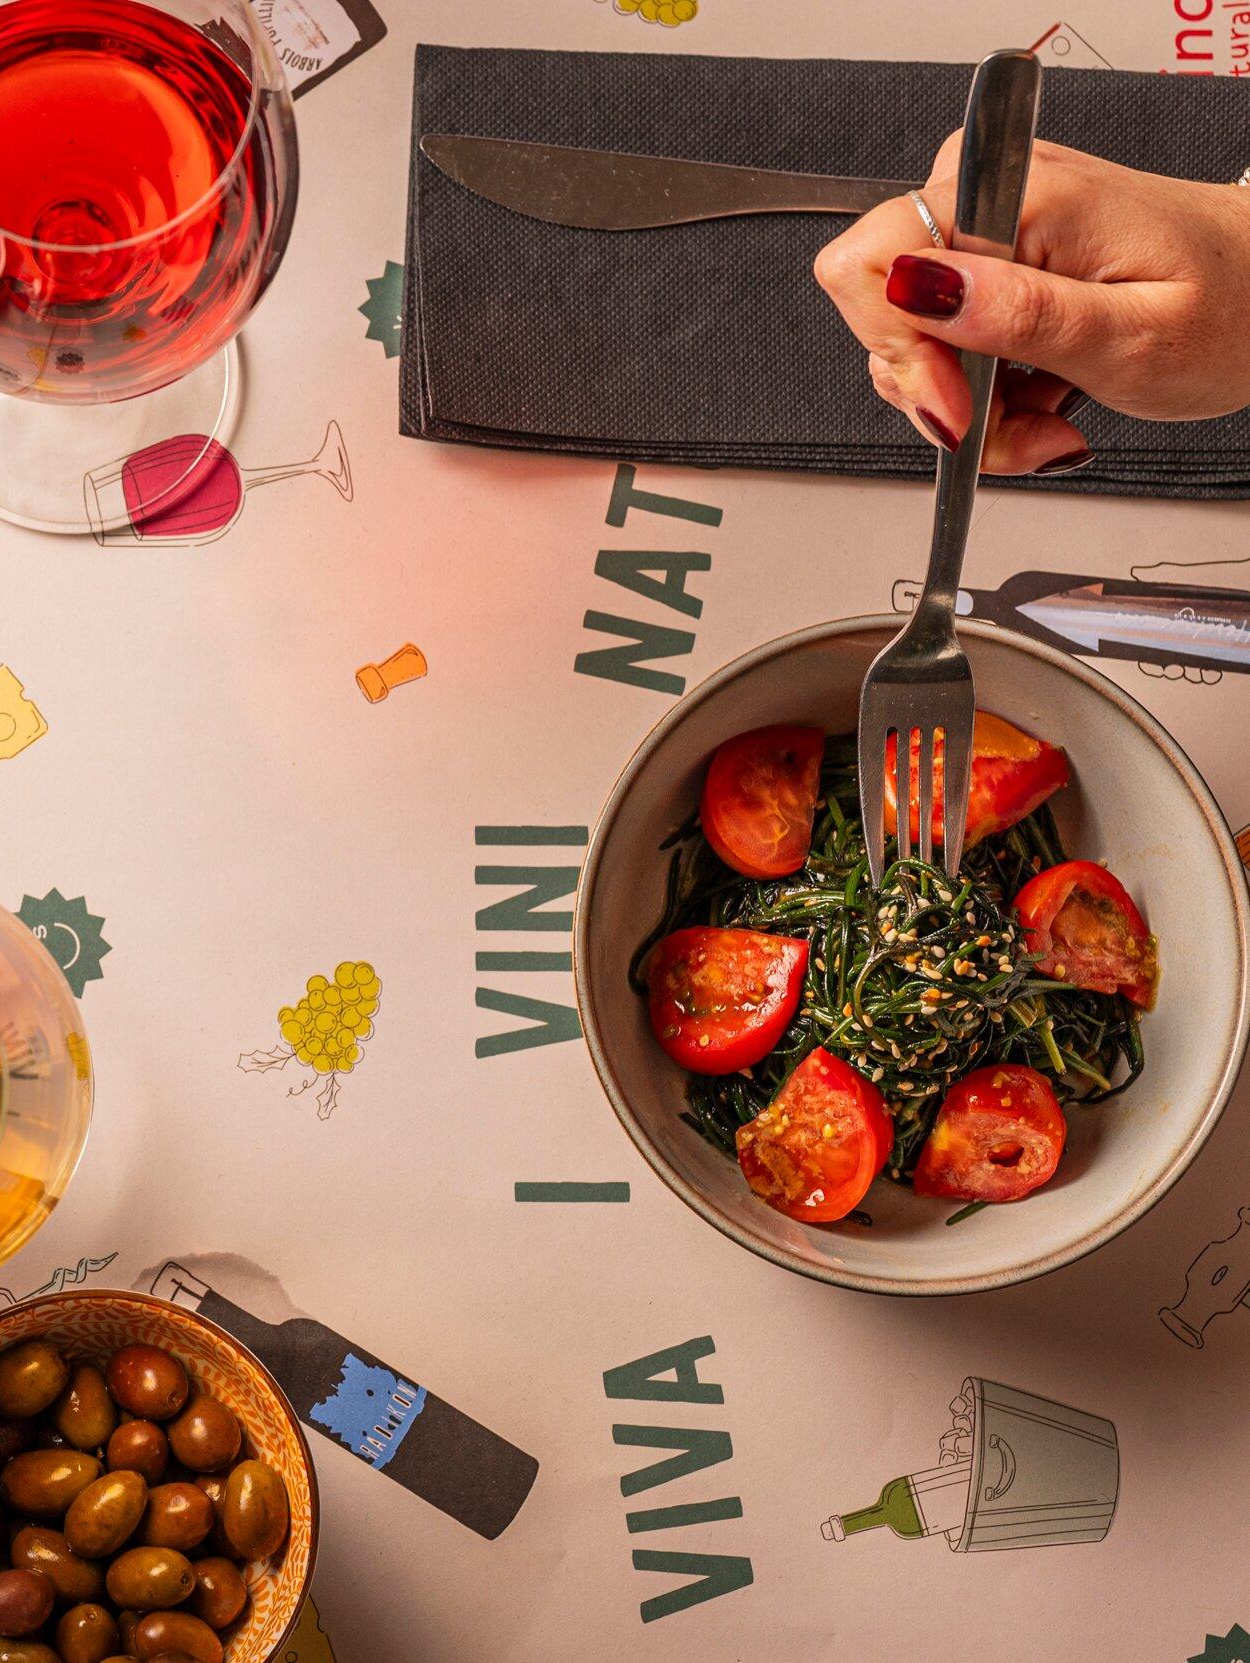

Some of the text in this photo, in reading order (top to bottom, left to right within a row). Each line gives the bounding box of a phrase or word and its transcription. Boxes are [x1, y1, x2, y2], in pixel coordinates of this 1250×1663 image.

[279, 48, 324, 71] ARBOIS
[574, 463, 723, 696] NAT
[474, 826, 589, 1060] VINI
[514, 1182, 631, 1203] I
[359, 1383, 417, 1460] RADIKON
[602, 1335, 754, 1624] VIVA
